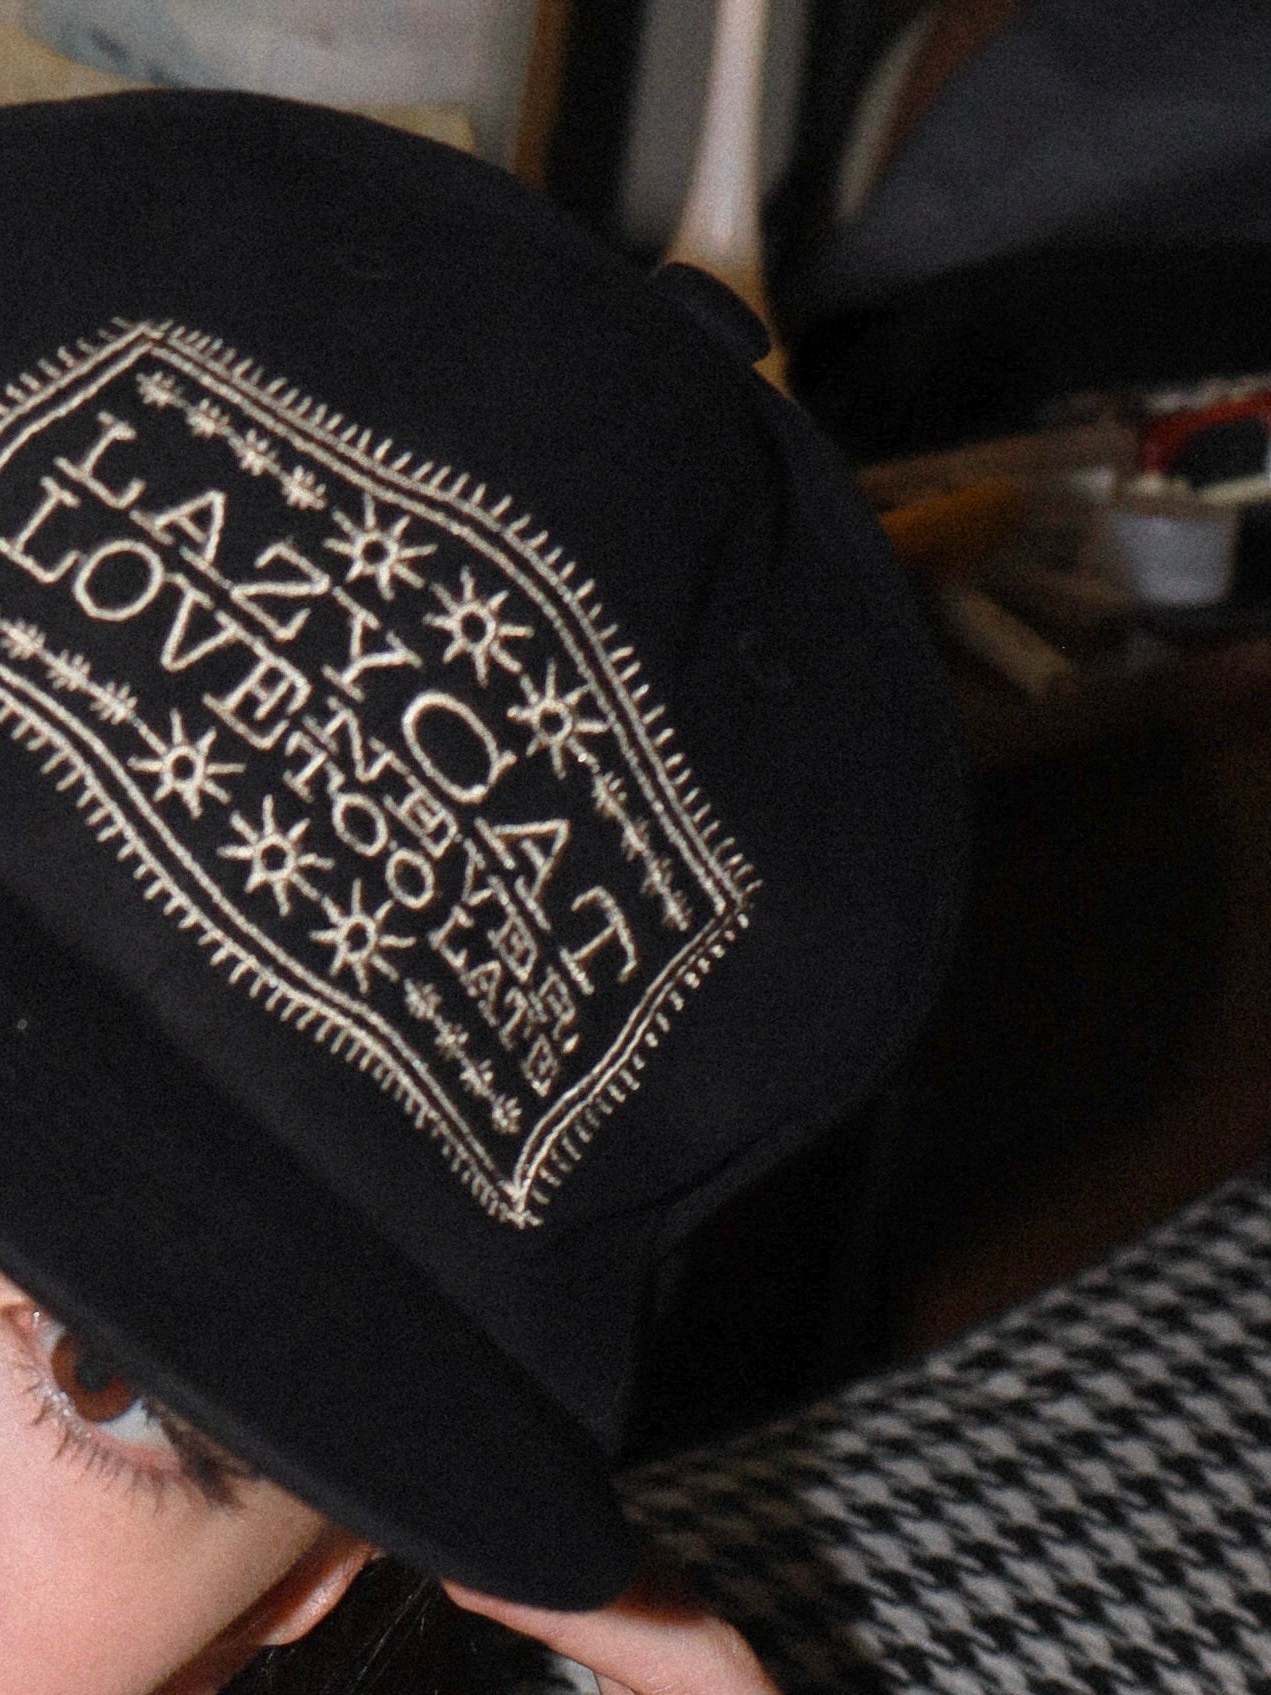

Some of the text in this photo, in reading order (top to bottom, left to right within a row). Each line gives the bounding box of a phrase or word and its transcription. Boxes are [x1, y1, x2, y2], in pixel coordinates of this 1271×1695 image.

[52, 410, 642, 997] LAZYCAT
[283, 729, 561, 1098] TOO LATE
